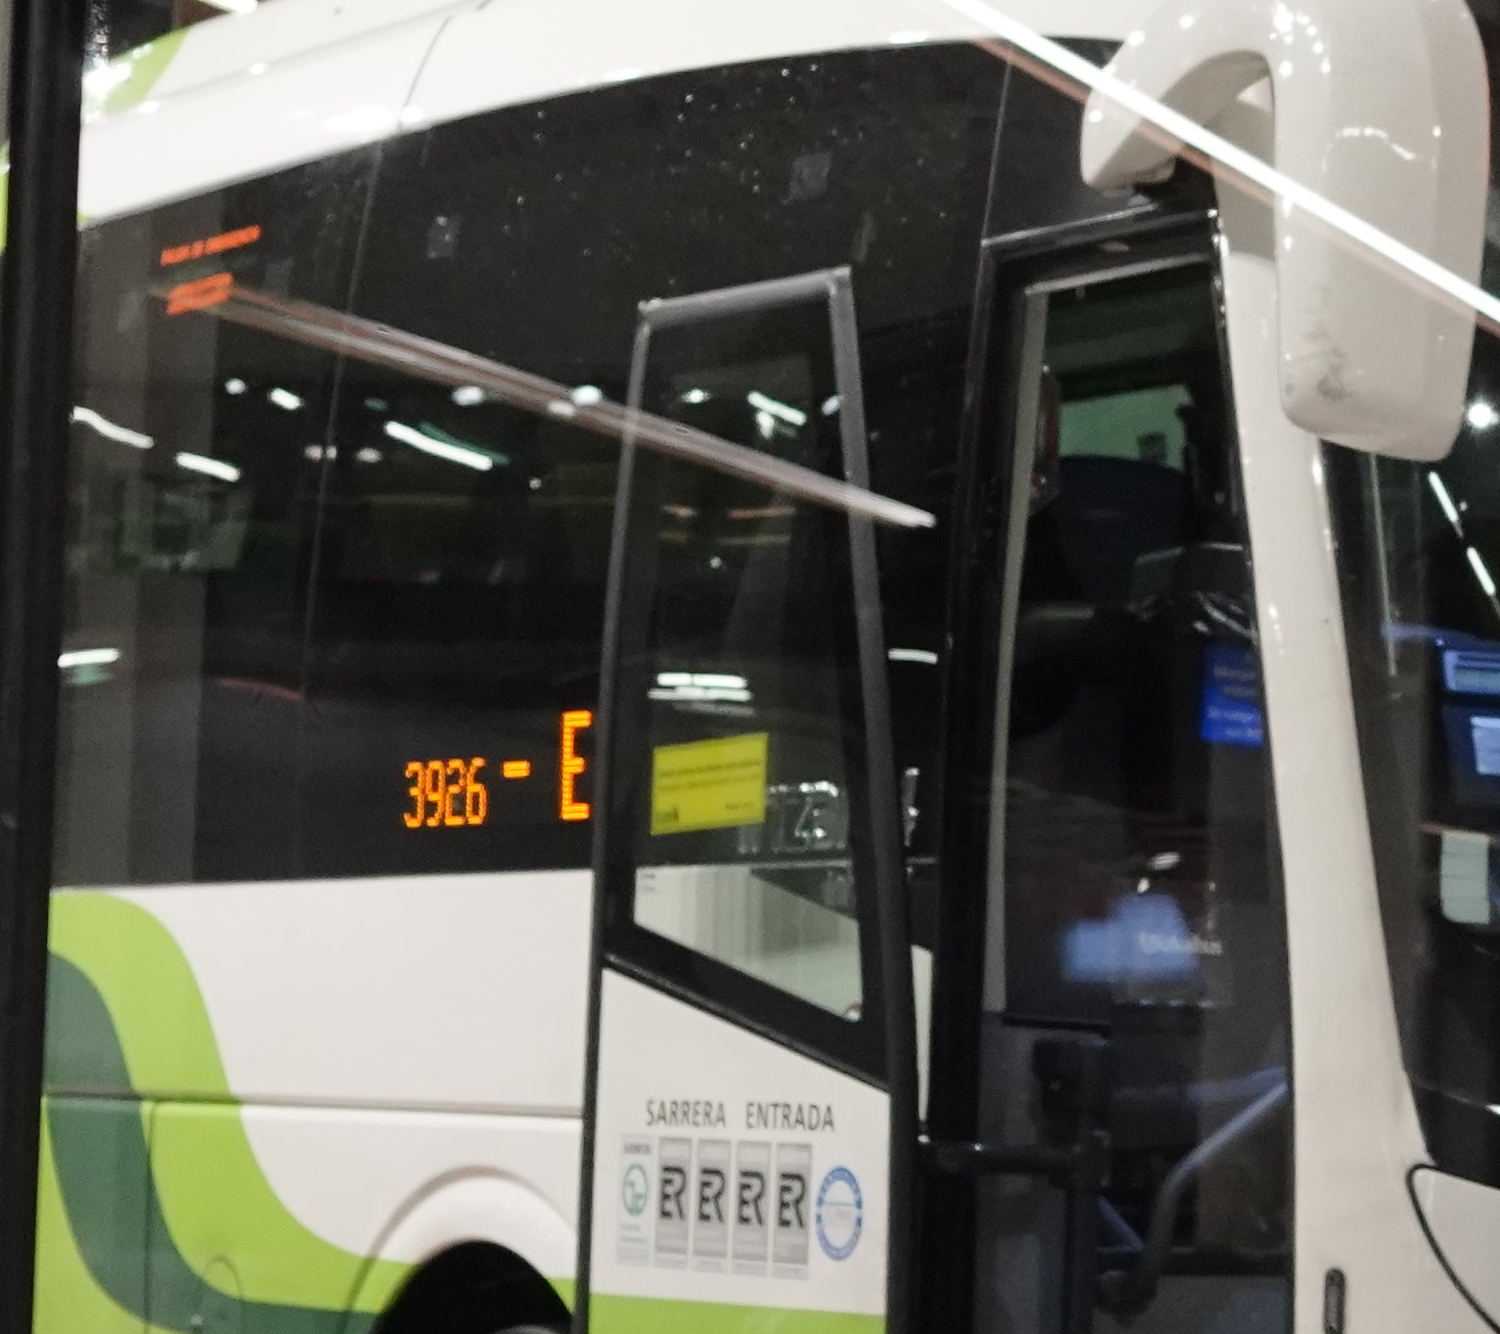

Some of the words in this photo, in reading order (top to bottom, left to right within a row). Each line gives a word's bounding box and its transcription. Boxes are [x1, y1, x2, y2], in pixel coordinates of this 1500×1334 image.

[402, 756, 488, 828] 3926
[645, 1098, 727, 1127] SARRERA
[745, 1101, 835, 1132] ENTRADA
